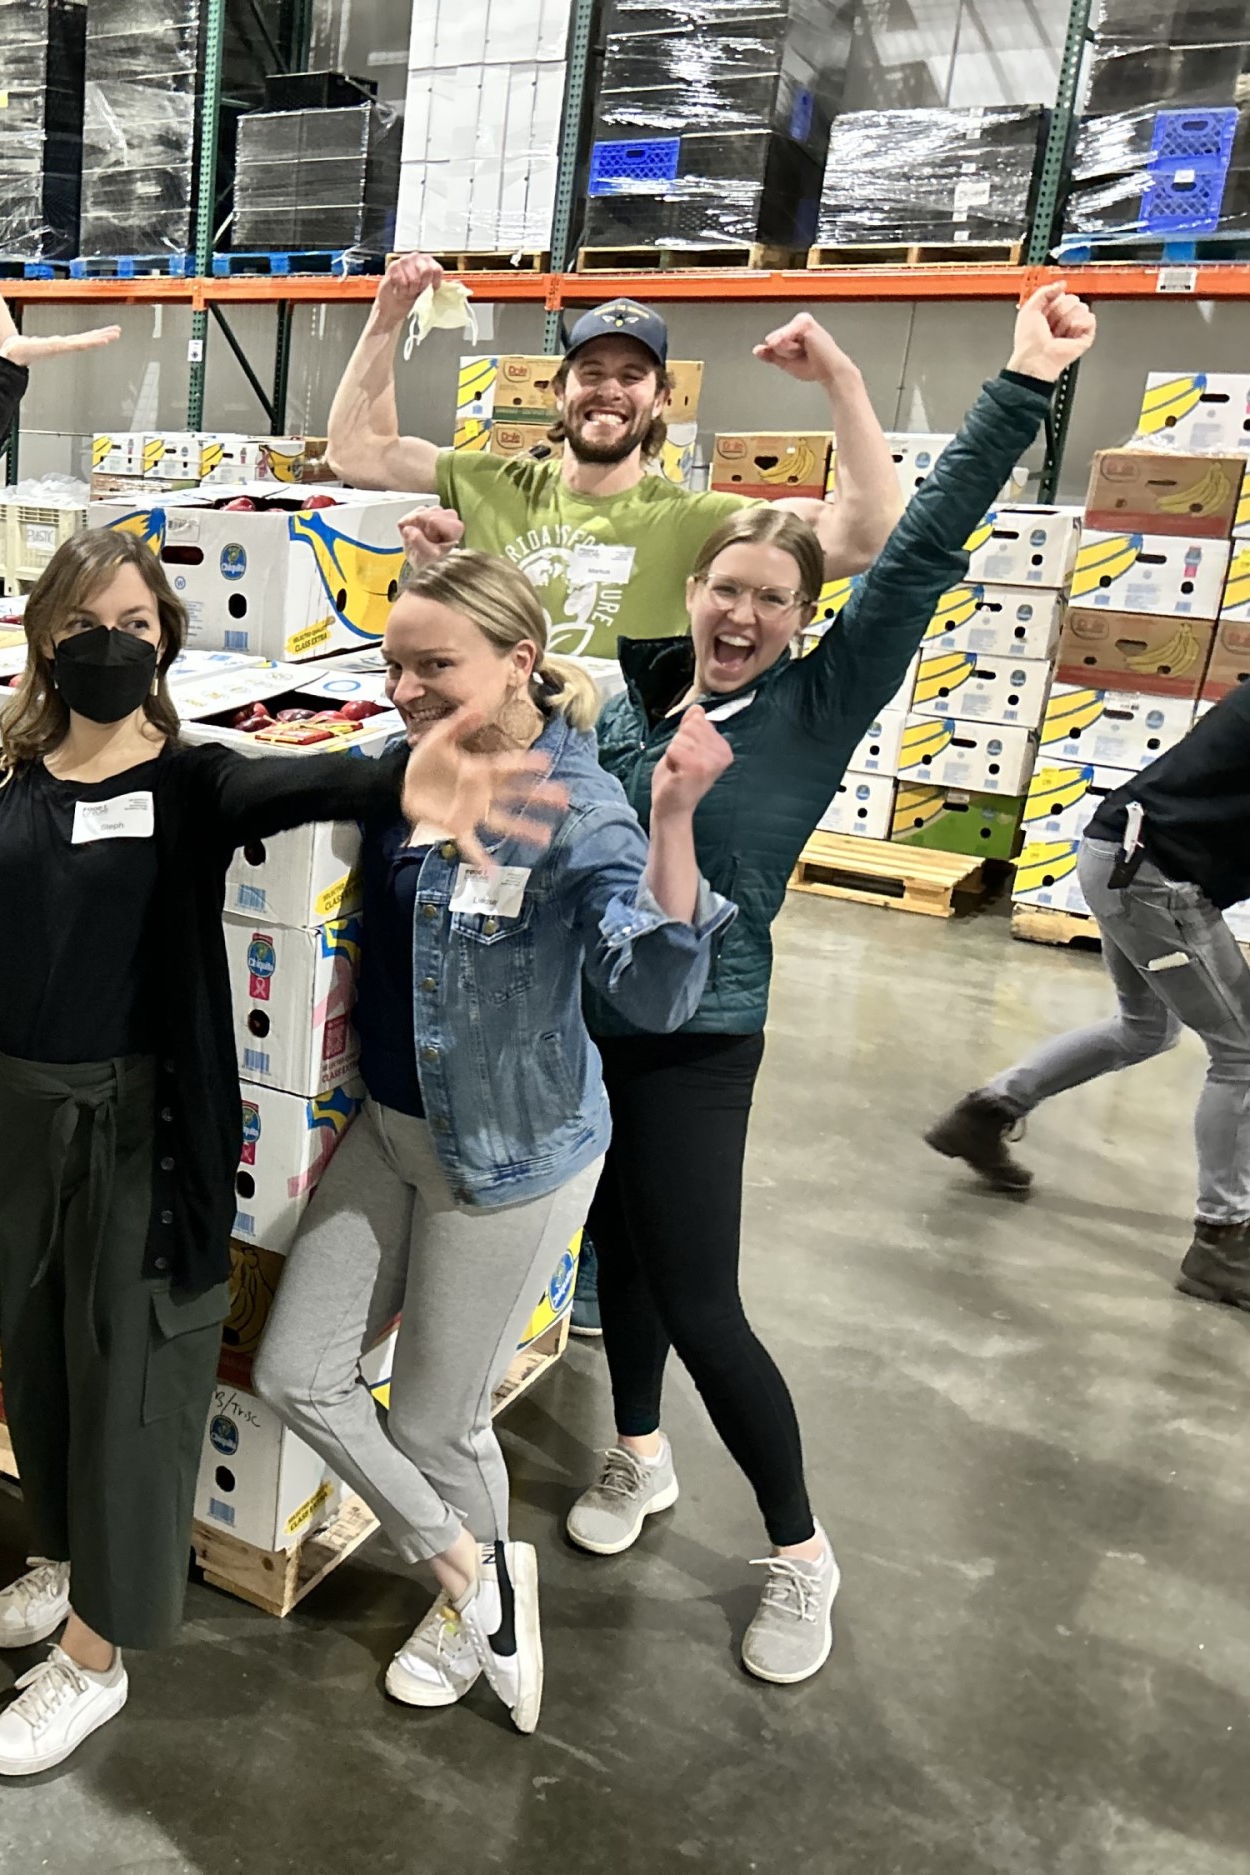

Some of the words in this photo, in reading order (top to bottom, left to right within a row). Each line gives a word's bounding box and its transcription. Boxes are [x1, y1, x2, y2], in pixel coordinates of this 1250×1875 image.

[508, 365, 528, 376] Dole
[501, 432, 520, 443] Dole
[295, 640, 311, 652] CLASS
[311, 632, 327, 645] EXTRA
[101, 821, 125, 831] Steph
[249, 957, 274, 972] Chiquita
